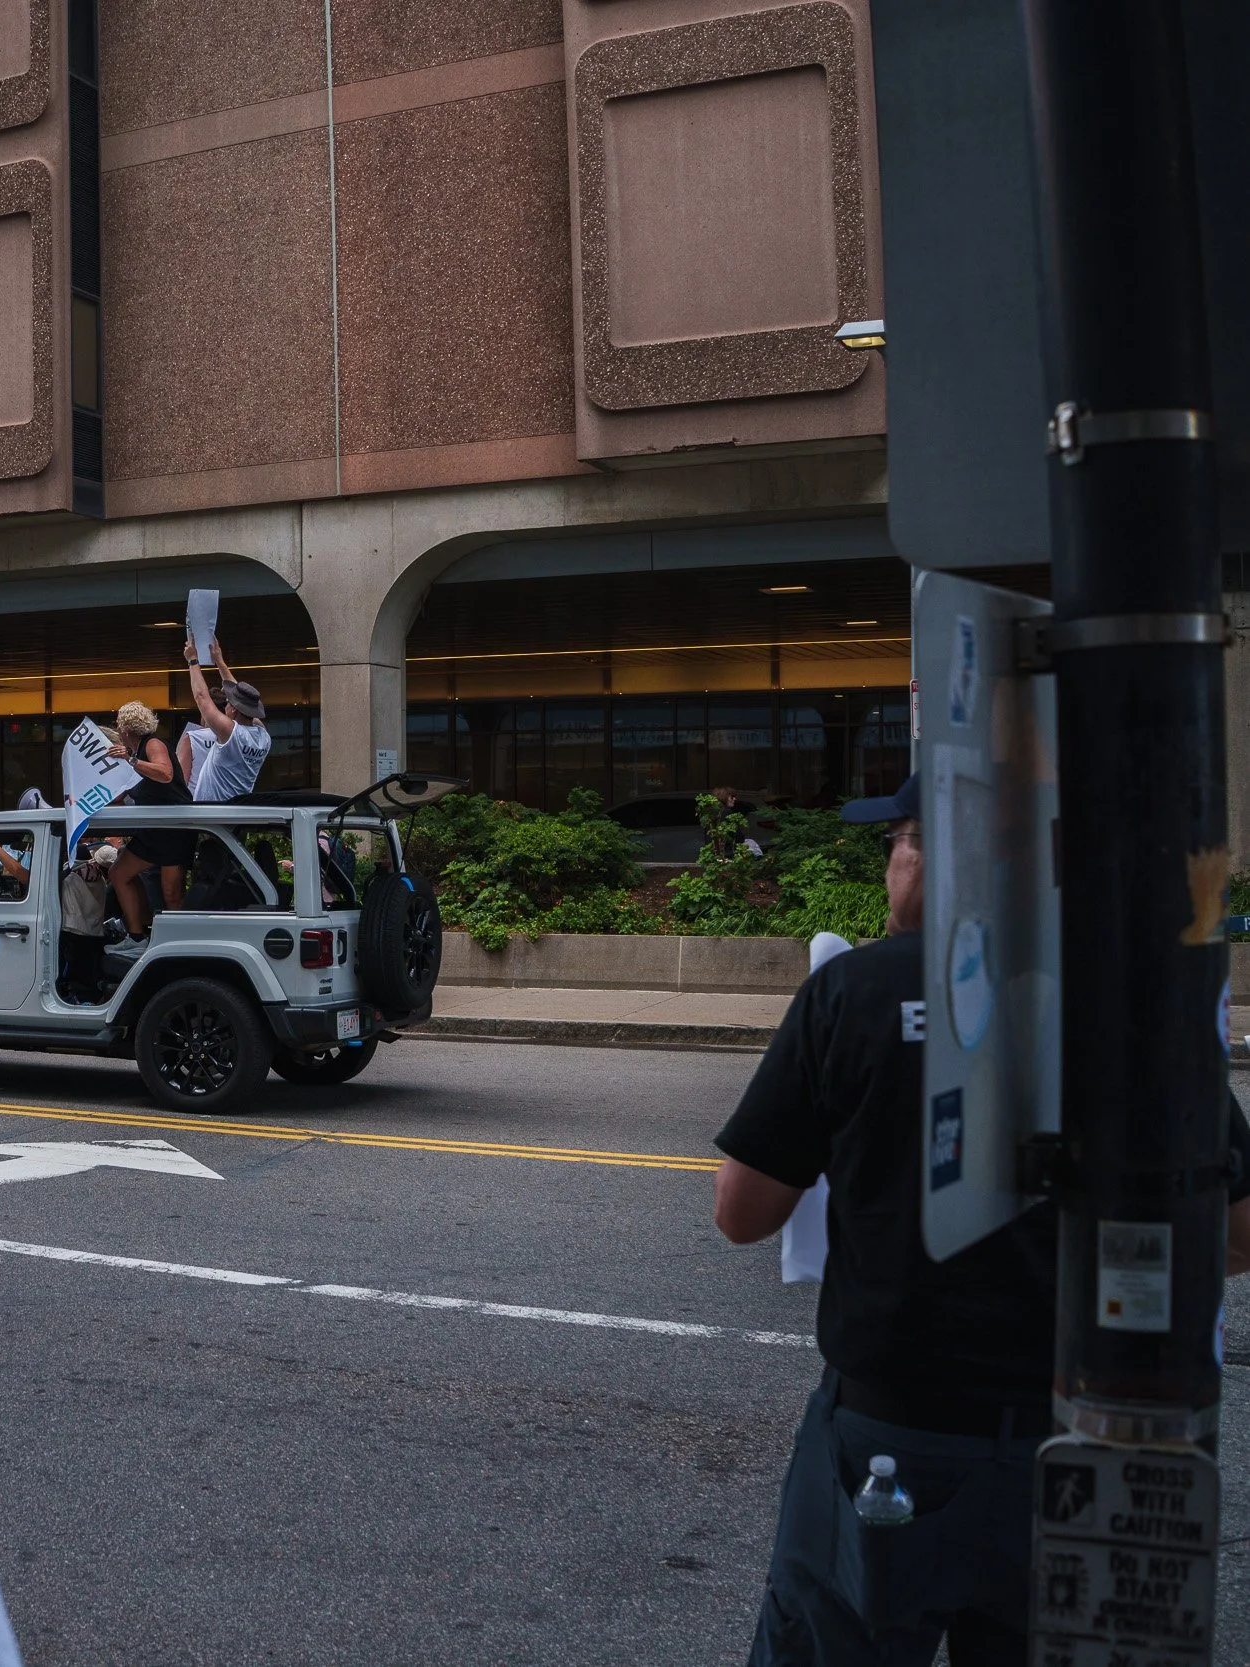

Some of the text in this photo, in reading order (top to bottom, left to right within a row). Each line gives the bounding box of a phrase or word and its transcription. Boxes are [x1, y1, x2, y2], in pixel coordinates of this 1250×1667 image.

[69, 723, 120, 776] BWH
[1122, 1462, 1195, 1490] CROSS
[1130, 1488, 1186, 1514] WITH
[1110, 1512, 1203, 1542] CAUTION
[1110, 1550, 1191, 1582] DO NOT
[1114, 1576, 1183, 1605] START
